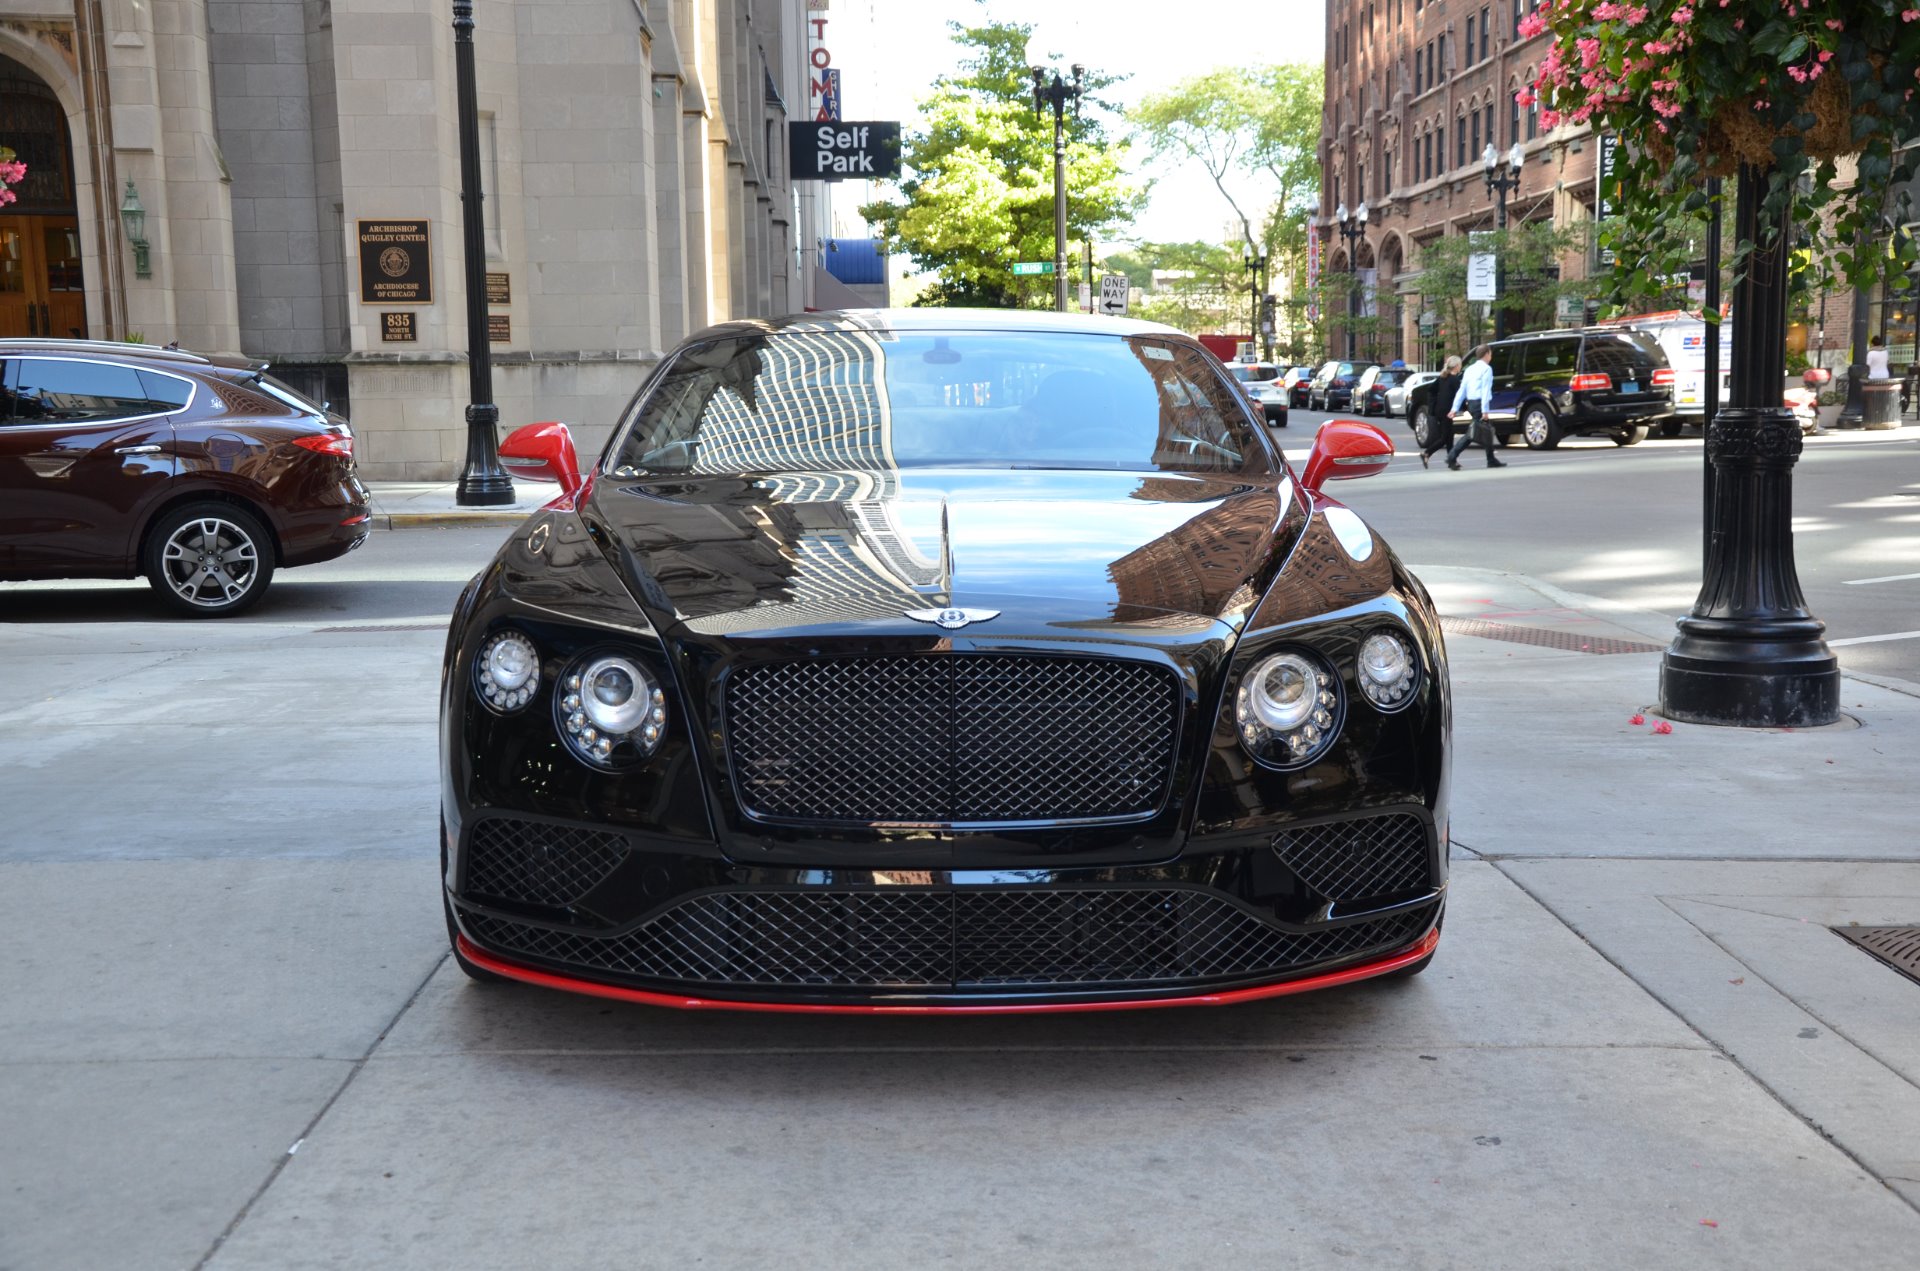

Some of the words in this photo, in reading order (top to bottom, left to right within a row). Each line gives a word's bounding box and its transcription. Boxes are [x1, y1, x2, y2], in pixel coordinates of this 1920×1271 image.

[817, 126, 869, 149] Self
[817, 150, 874, 173] Park
[361, 234, 395, 243] QUIGLEY
[1022, 263, 1043, 273] RUSH
[1104, 277, 1125, 288] ONE
[1103, 289, 1126, 299] WAY
[387, 314, 410, 326] 835
